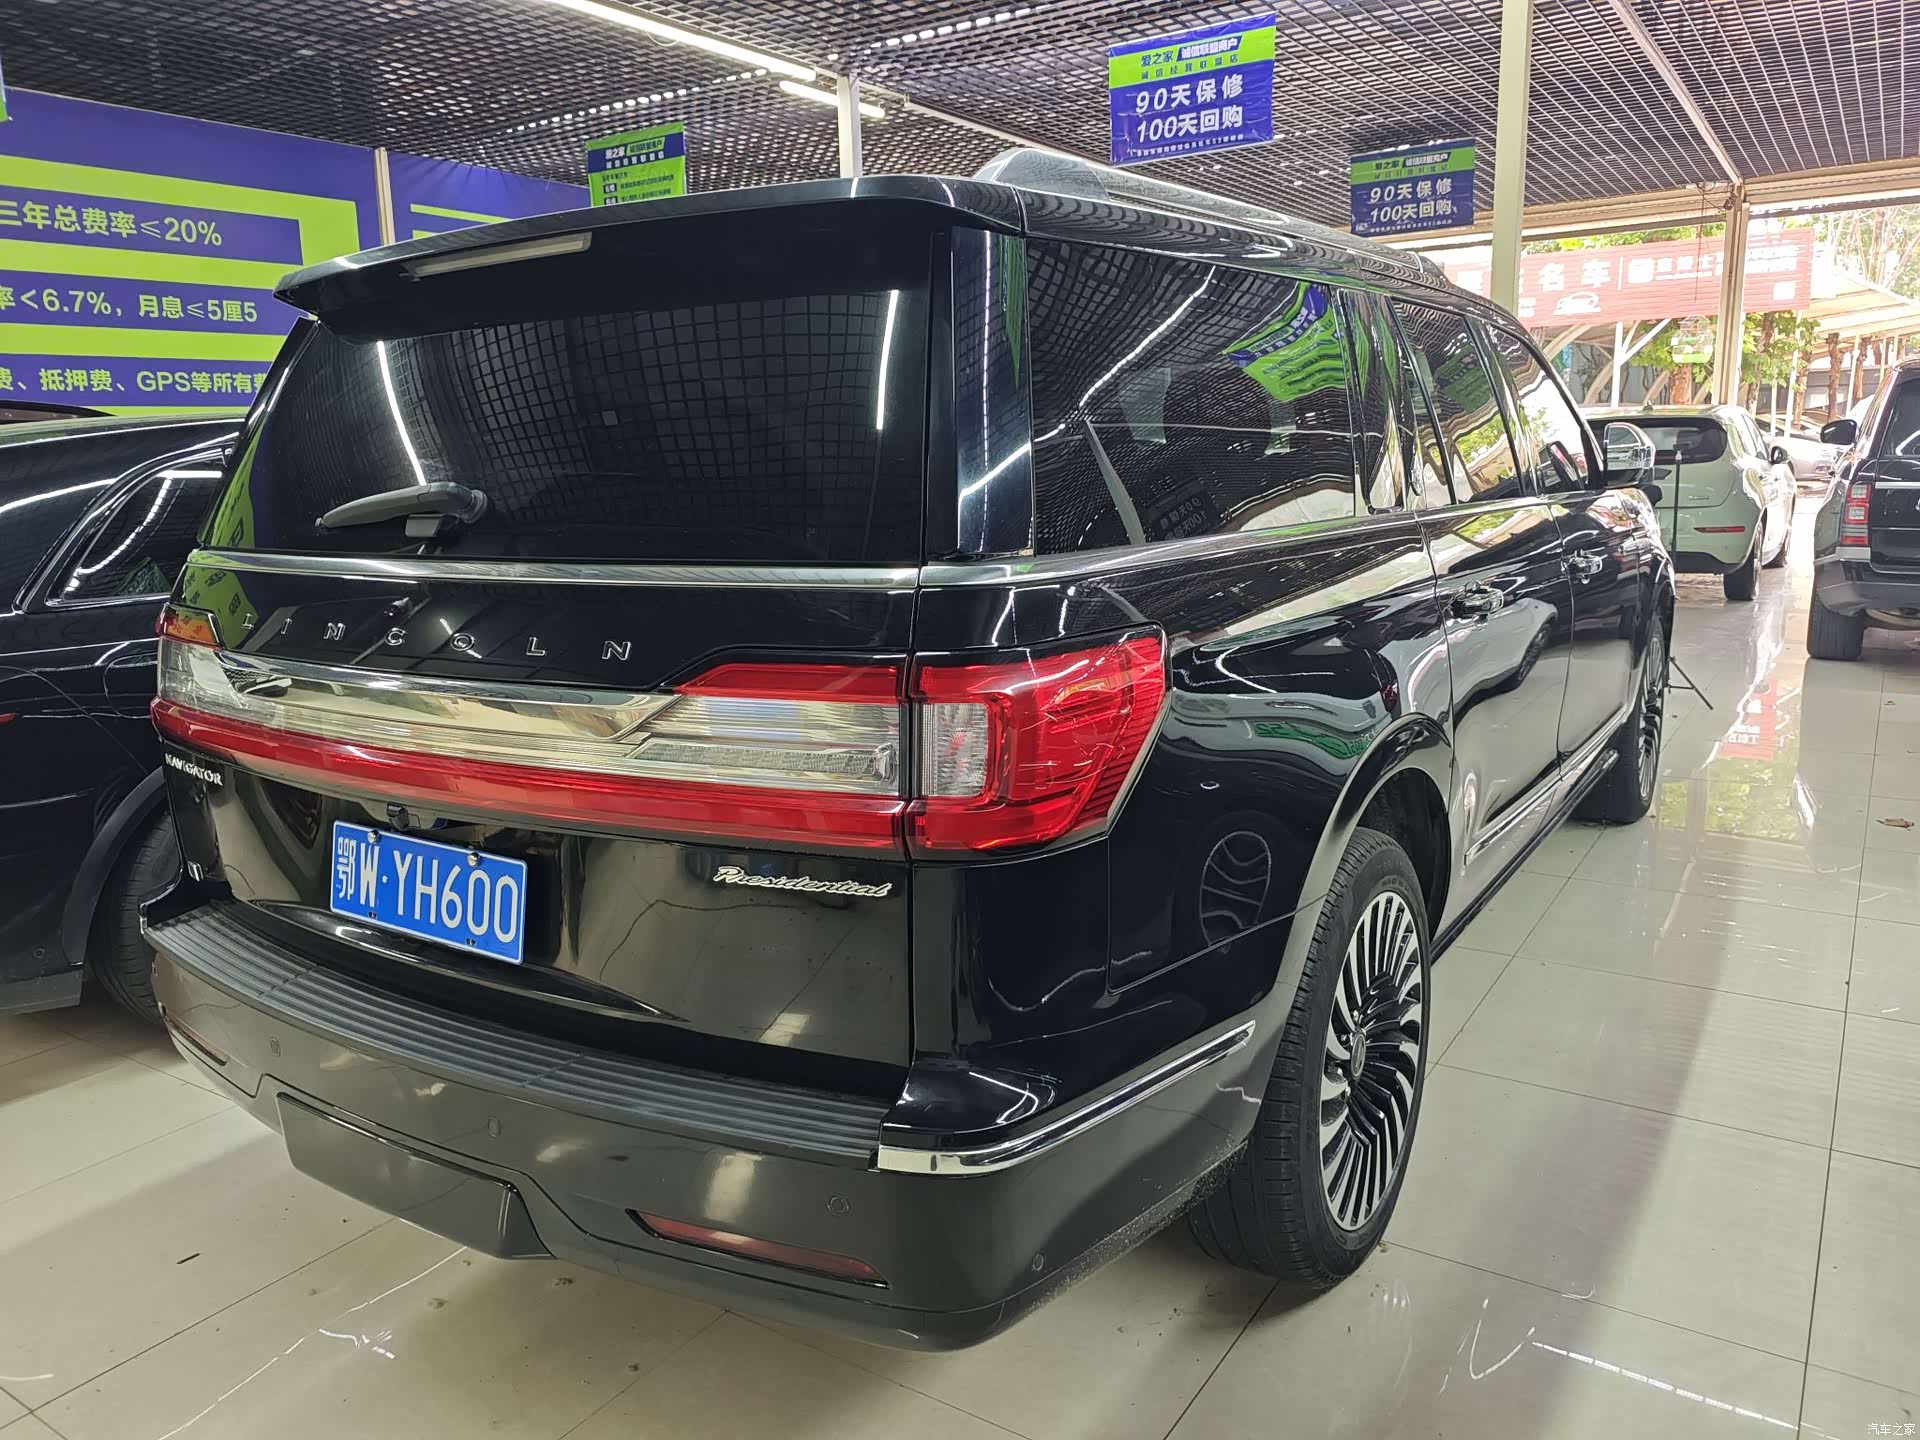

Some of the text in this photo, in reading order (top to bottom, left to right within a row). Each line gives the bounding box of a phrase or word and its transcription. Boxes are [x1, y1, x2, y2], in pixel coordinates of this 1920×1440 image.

[1136, 73, 1244, 113] 90天保修
[1137, 105, 1243, 143] 100天回购
[1370, 177, 1452, 204] 90天保修
[1370, 199, 1452, 223] 100天回购
[241, 613, 632, 662] LINCOLN
[165, 752, 223, 786] NAVIGATOR
[713, 866, 893, 897] Presidential
